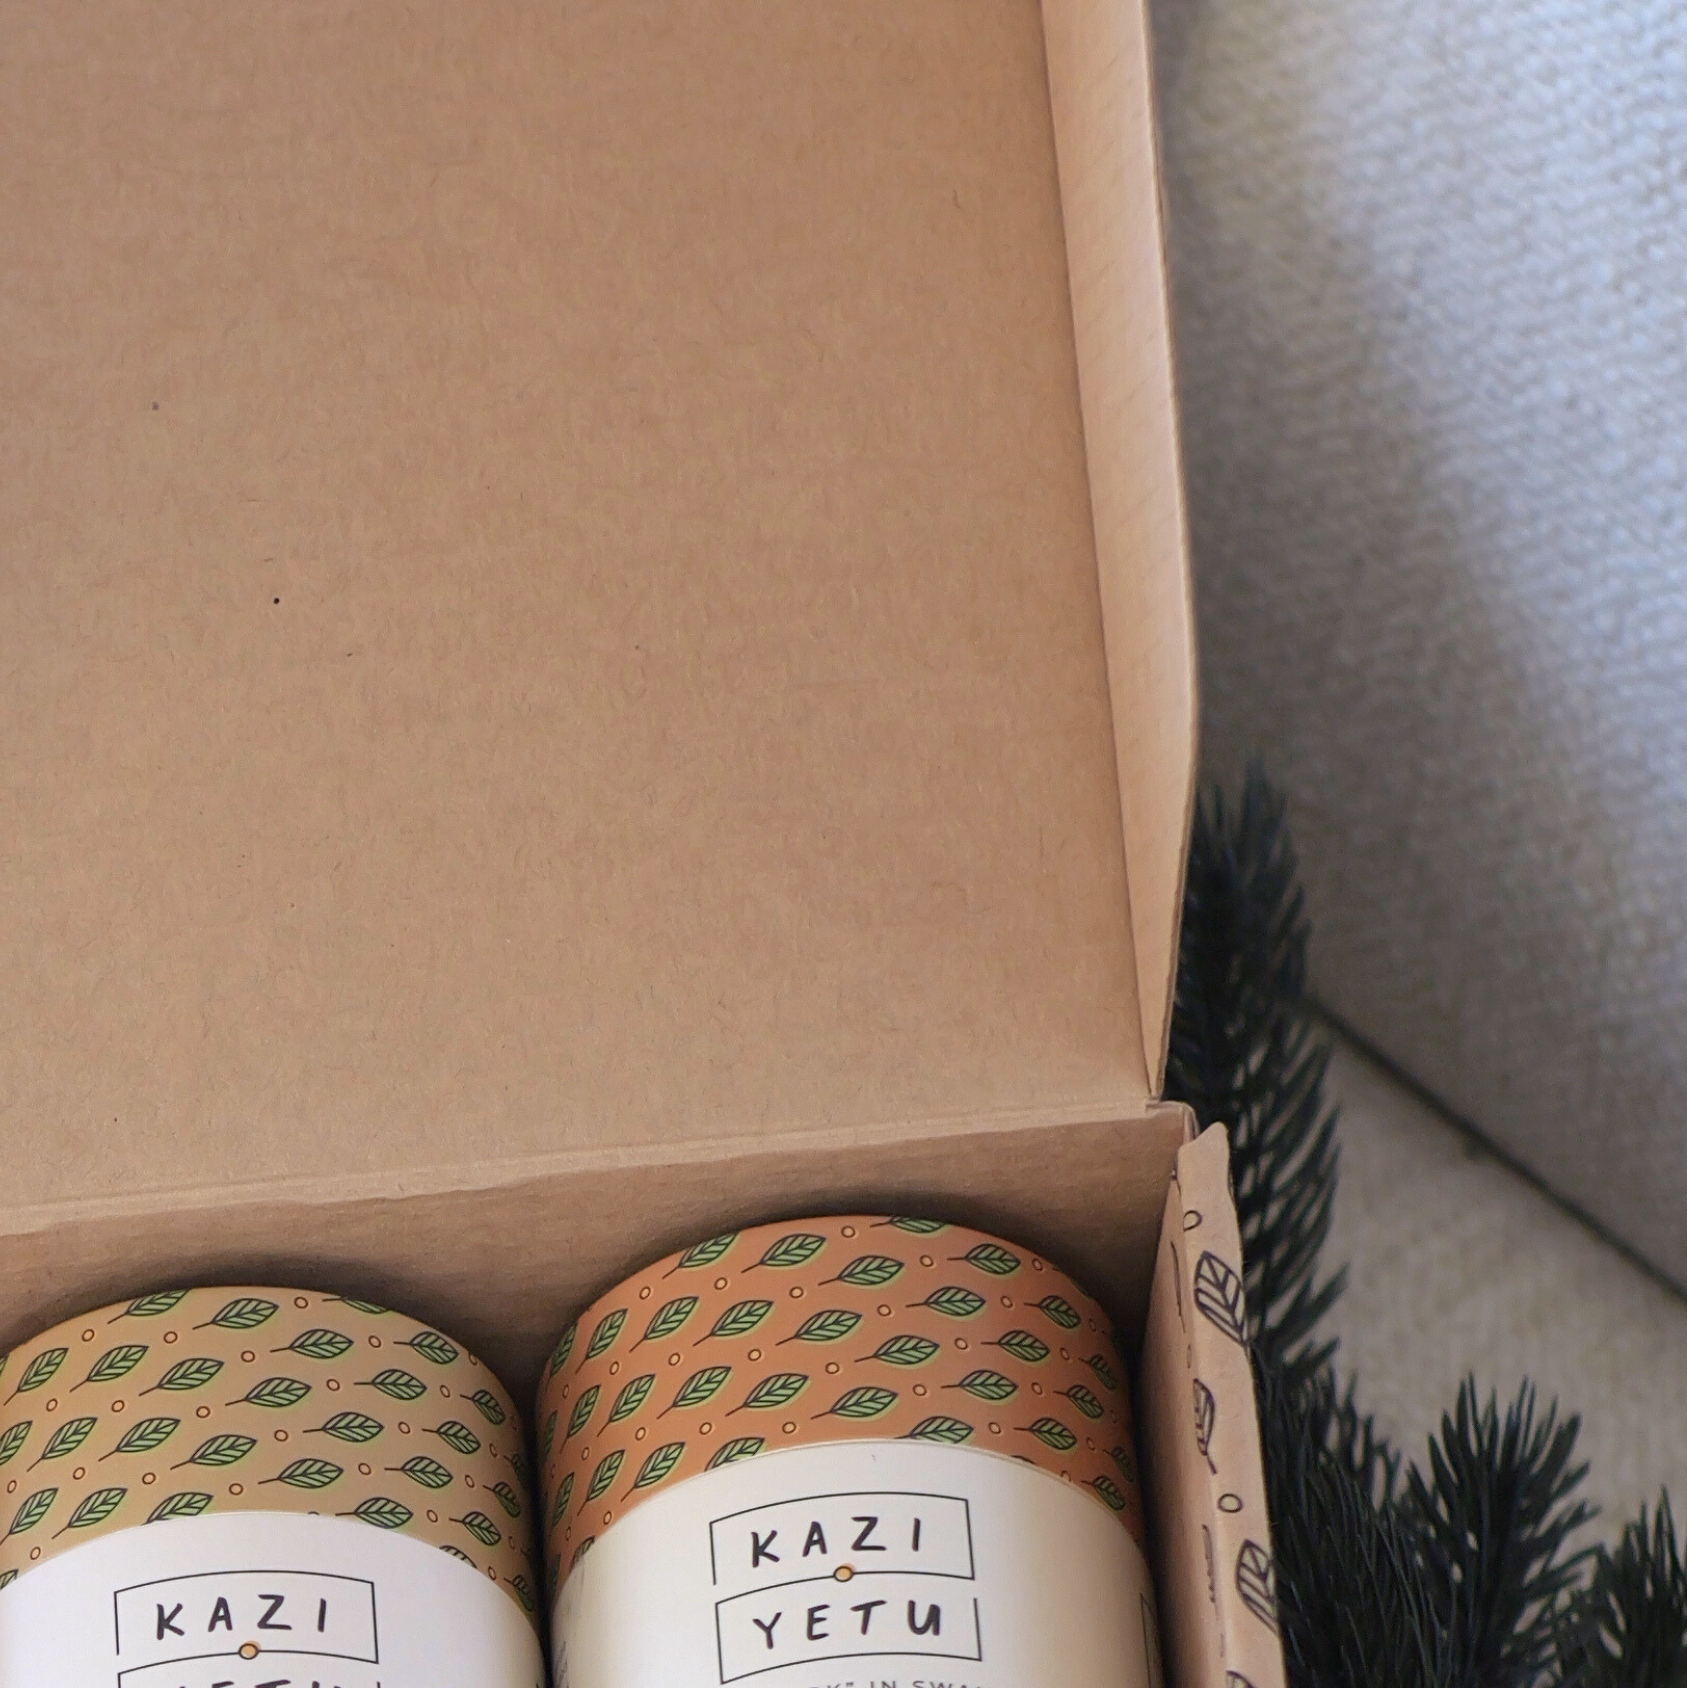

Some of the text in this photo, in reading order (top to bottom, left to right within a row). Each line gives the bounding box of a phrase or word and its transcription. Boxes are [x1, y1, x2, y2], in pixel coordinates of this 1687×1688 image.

[751, 1516, 920, 1567] KAZI
[156, 1594, 327, 1639] KAZI
[754, 1600, 940, 1649] YETU
